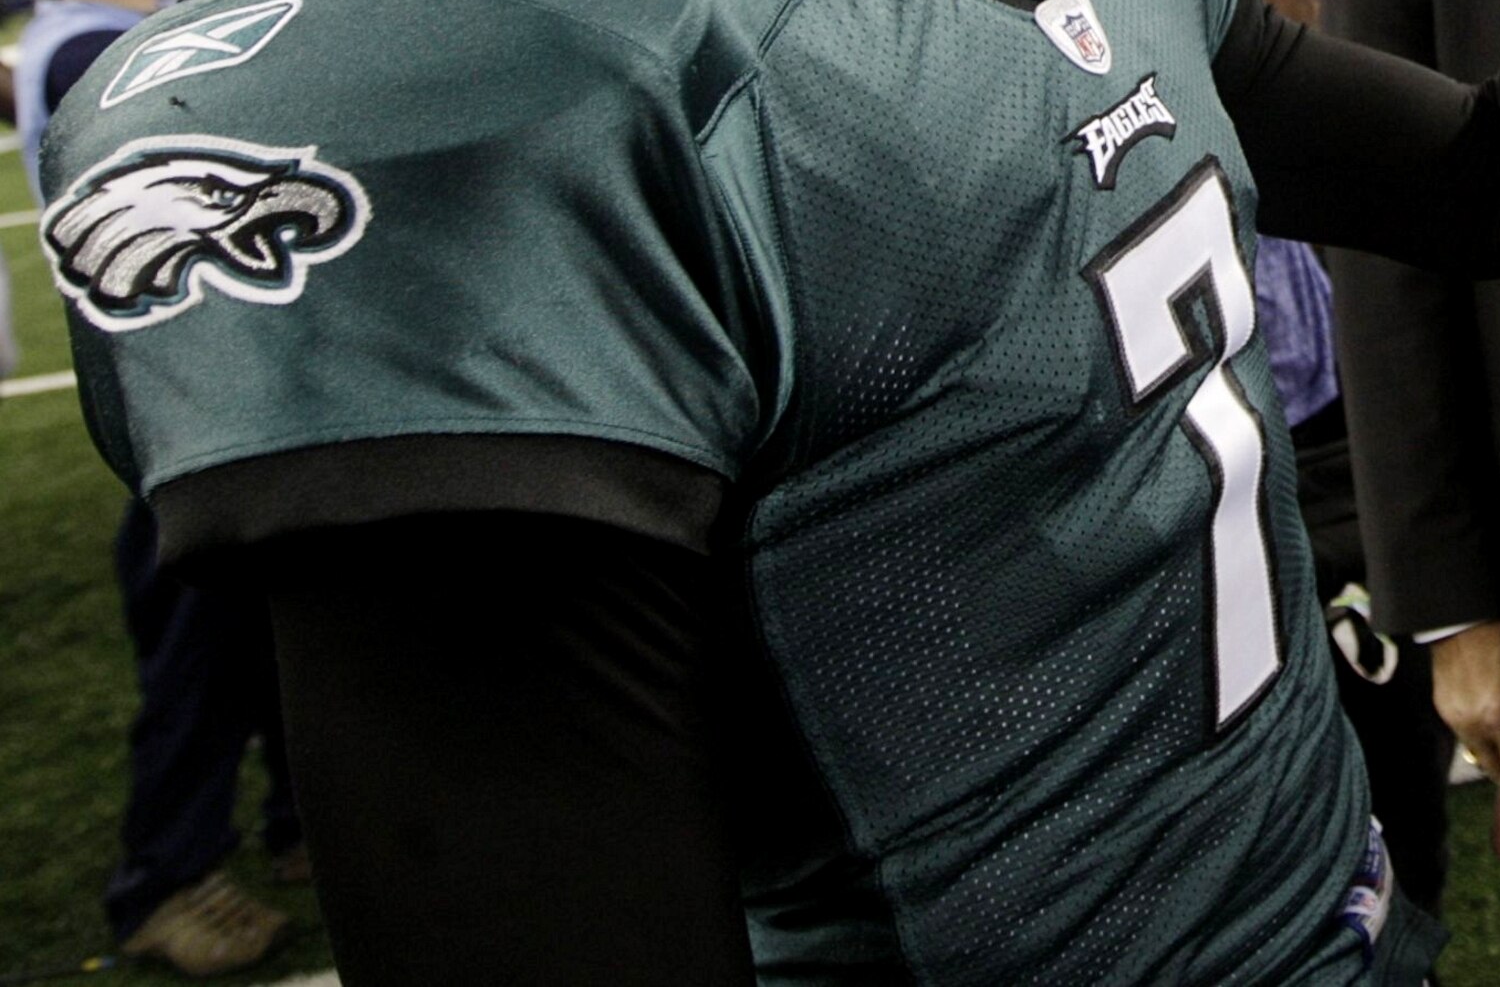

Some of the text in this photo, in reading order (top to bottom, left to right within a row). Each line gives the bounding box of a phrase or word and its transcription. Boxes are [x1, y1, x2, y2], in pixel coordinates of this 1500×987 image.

[1076, 30, 1105, 59] NFL
[1077, 75, 1176, 183] EAGLES
[1098, 170, 1282, 729] 7
